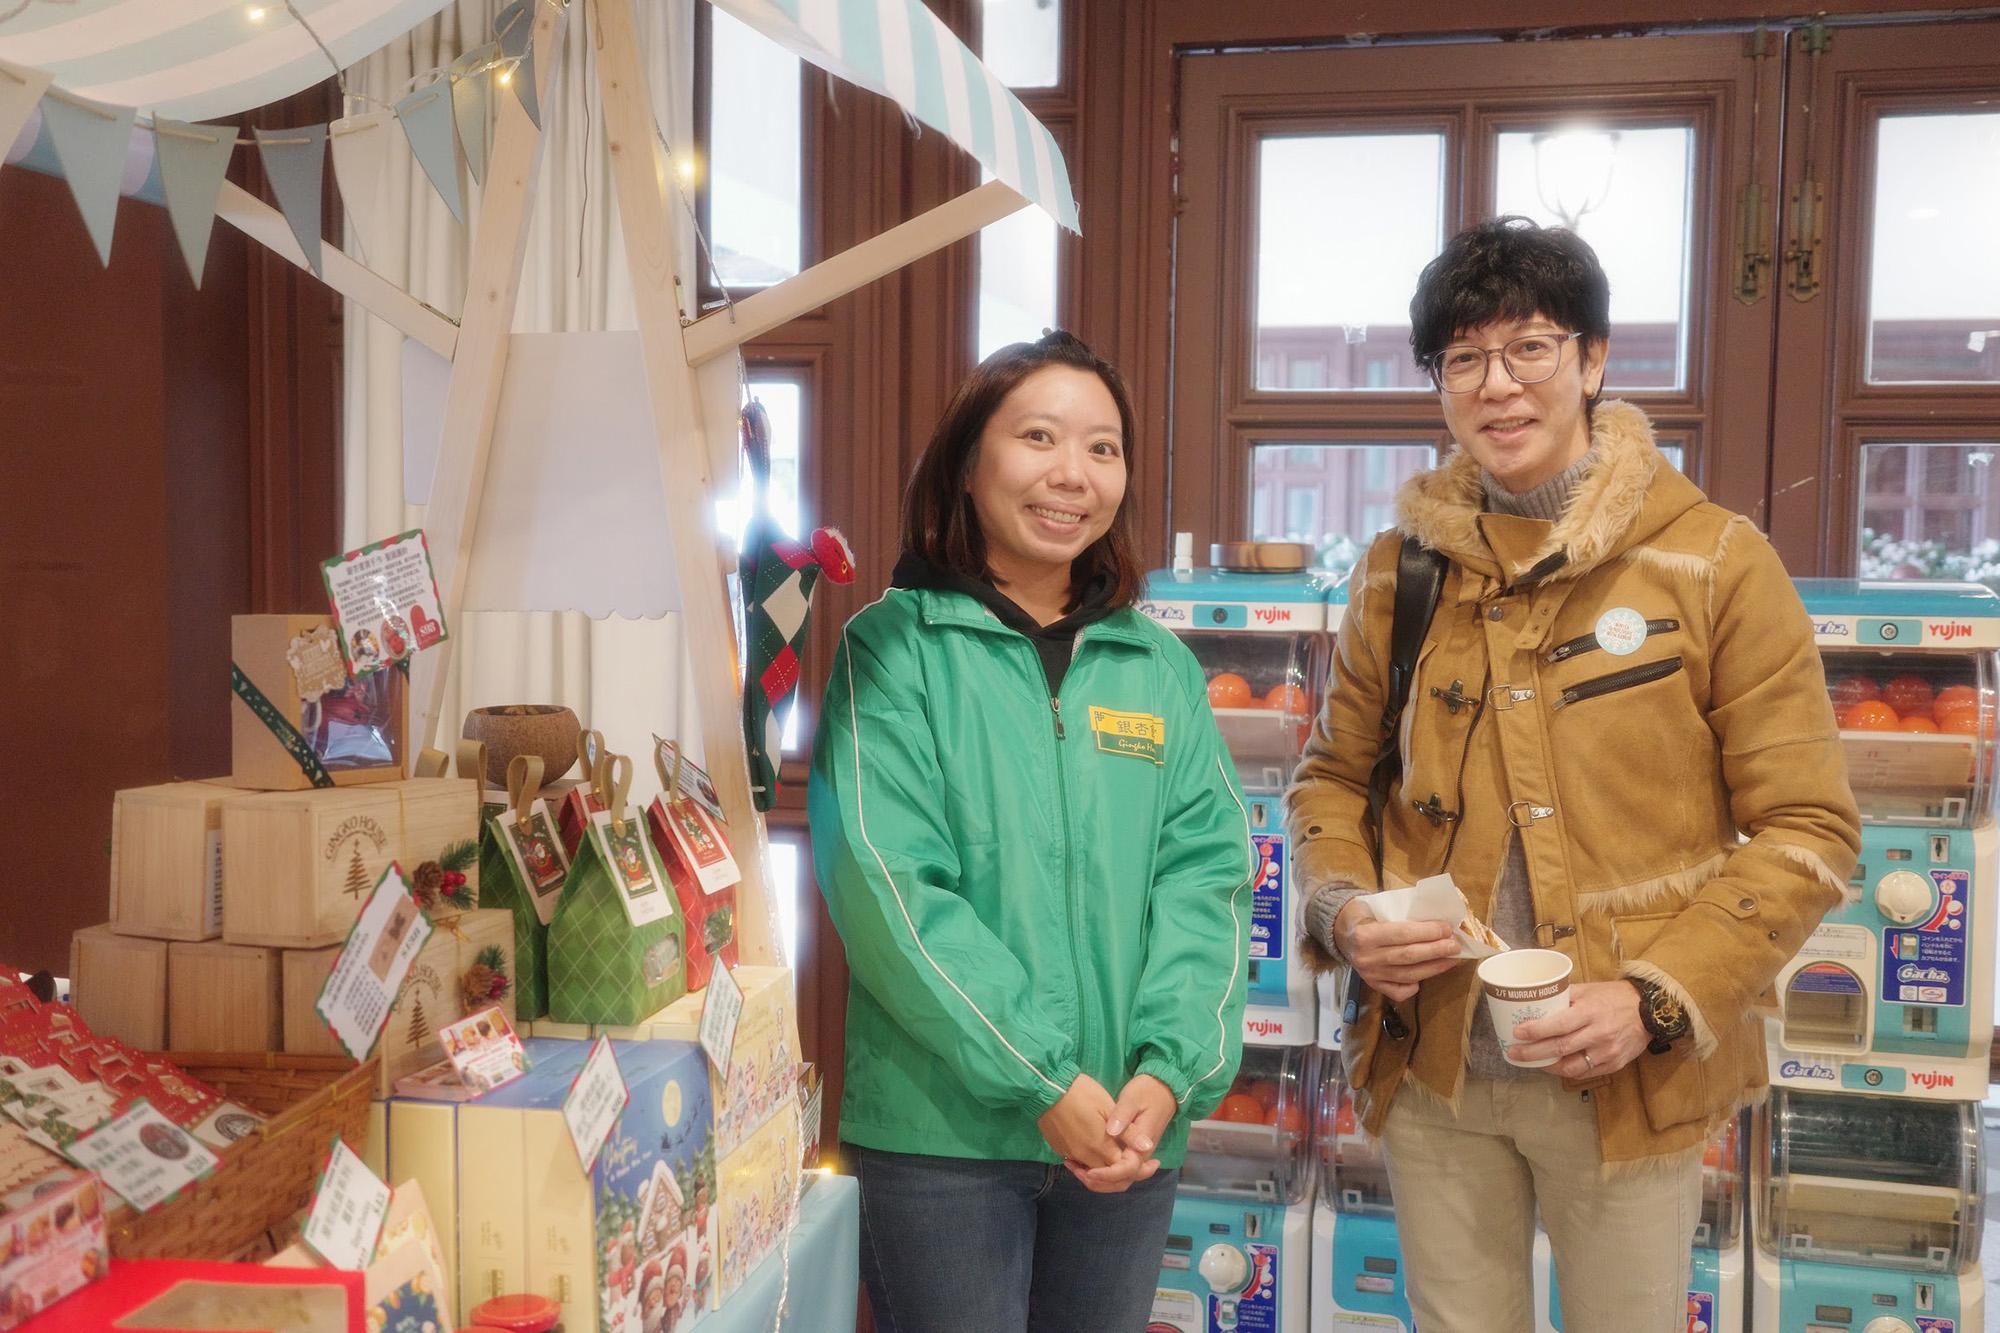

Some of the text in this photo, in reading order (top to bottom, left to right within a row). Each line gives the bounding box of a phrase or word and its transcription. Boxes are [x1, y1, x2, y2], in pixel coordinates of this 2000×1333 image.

[325, 815, 388, 862] GINGKO HOUSE
[1495, 983, 1559, 999] 2/F MURRAY HOUSE
